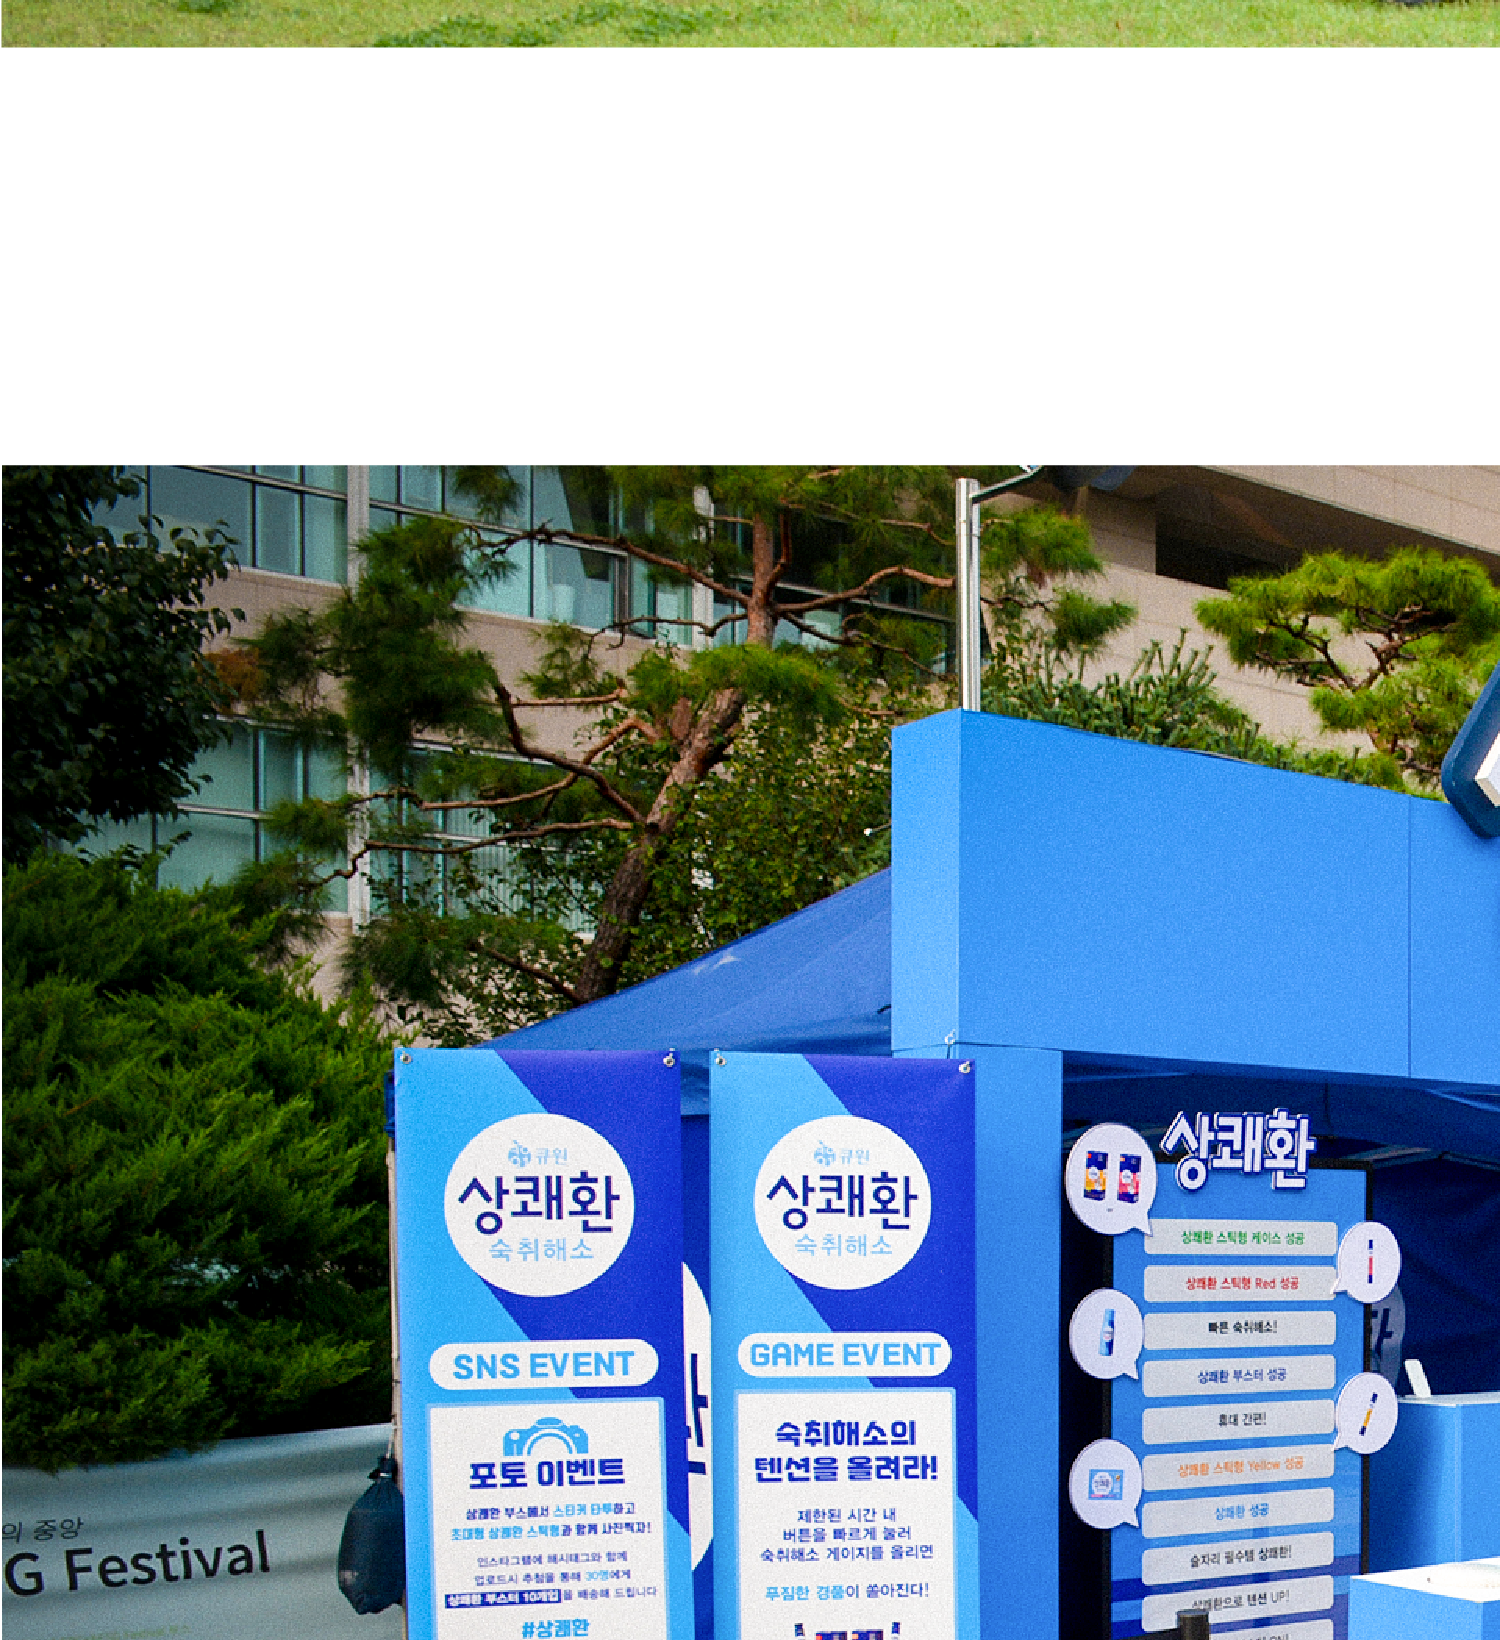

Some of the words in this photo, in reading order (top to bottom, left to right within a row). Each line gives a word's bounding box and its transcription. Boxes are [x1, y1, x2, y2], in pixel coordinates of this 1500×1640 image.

[1161, 1107, 1317, 1190] 상쾌환
[458, 1170, 620, 1235] 상쾌환
[767, 1171, 919, 1230] 상쾌환
[488, 1237, 594, 1262] 숙취해소
[795, 1234, 893, 1256] 숙취해소
[453, 1353, 520, 1379] SNS
[530, 1350, 634, 1379] EVENT
[751, 1342, 834, 1367] GAME
[843, 1342, 941, 1367] EVENT
[776, 1420, 916, 1447] 숙취해소의
[469, 1462, 528, 1489] 포토
[537, 1458, 625, 1486] 이벤트
[755, 1456, 839, 1483] 텐션을
[847, 1455, 938, 1482] 올려라!
[34, 1517, 83, 1540] 중앙
[848, 1508, 877, 1523] 시간
[883, 1508, 896, 1522] 내
[64, 1529, 270, 1591] Festival
[761, 1547, 820, 1562] 숙취해소
[765, 1585, 810, 1601] 푸짐한
[522, 1618, 590, 1639] #상쾌환
